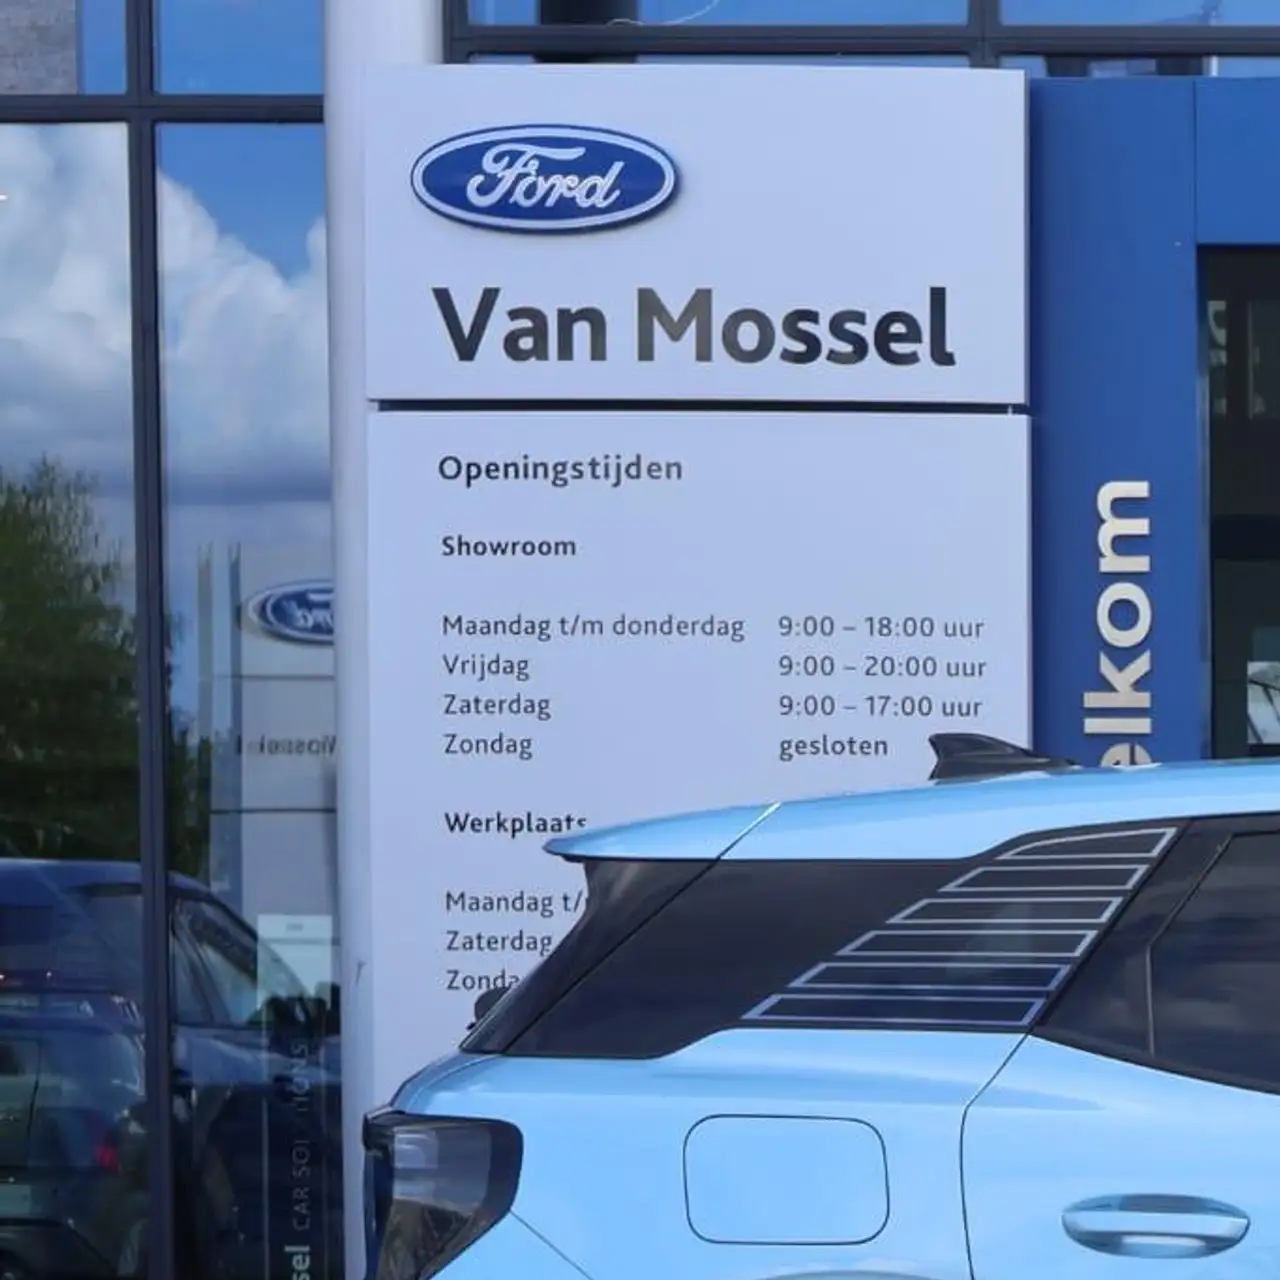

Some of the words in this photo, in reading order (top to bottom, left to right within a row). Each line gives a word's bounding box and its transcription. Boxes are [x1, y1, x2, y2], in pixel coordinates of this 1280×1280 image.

[466, 141, 626, 208] Ford
[431, 286, 607, 362] Van
[637, 286, 957, 367] Mossel
[438, 454, 683, 490] Openingstijden
[441, 534, 577, 558] Showroom
[442, 613, 553, 643] Maandag
[558, 614, 605, 637] t/m
[612, 613, 746, 643] donderdag
[778, 615, 836, 638] 9:00
[864, 616, 936, 639] 18:00
[943, 621, 986, 639] uur
[442, 653, 531, 682] Vrijdag
[778, 654, 836, 677] 9:00
[864, 655, 939, 678] 20:00
[946, 661, 988, 679] uur
[443, 691, 552, 722] Zaterdag
[779, 694, 836, 717] 9:00
[864, 694, 934, 718] 17:00
[941, 701, 984, 718] uur
[443, 731, 533, 761] Zondag
[779, 733, 889, 763] gesloten
[445, 890, 554, 919] Maandag
[562, 890, 588, 914] t/
[446, 929, 553, 958] Zaterdag
